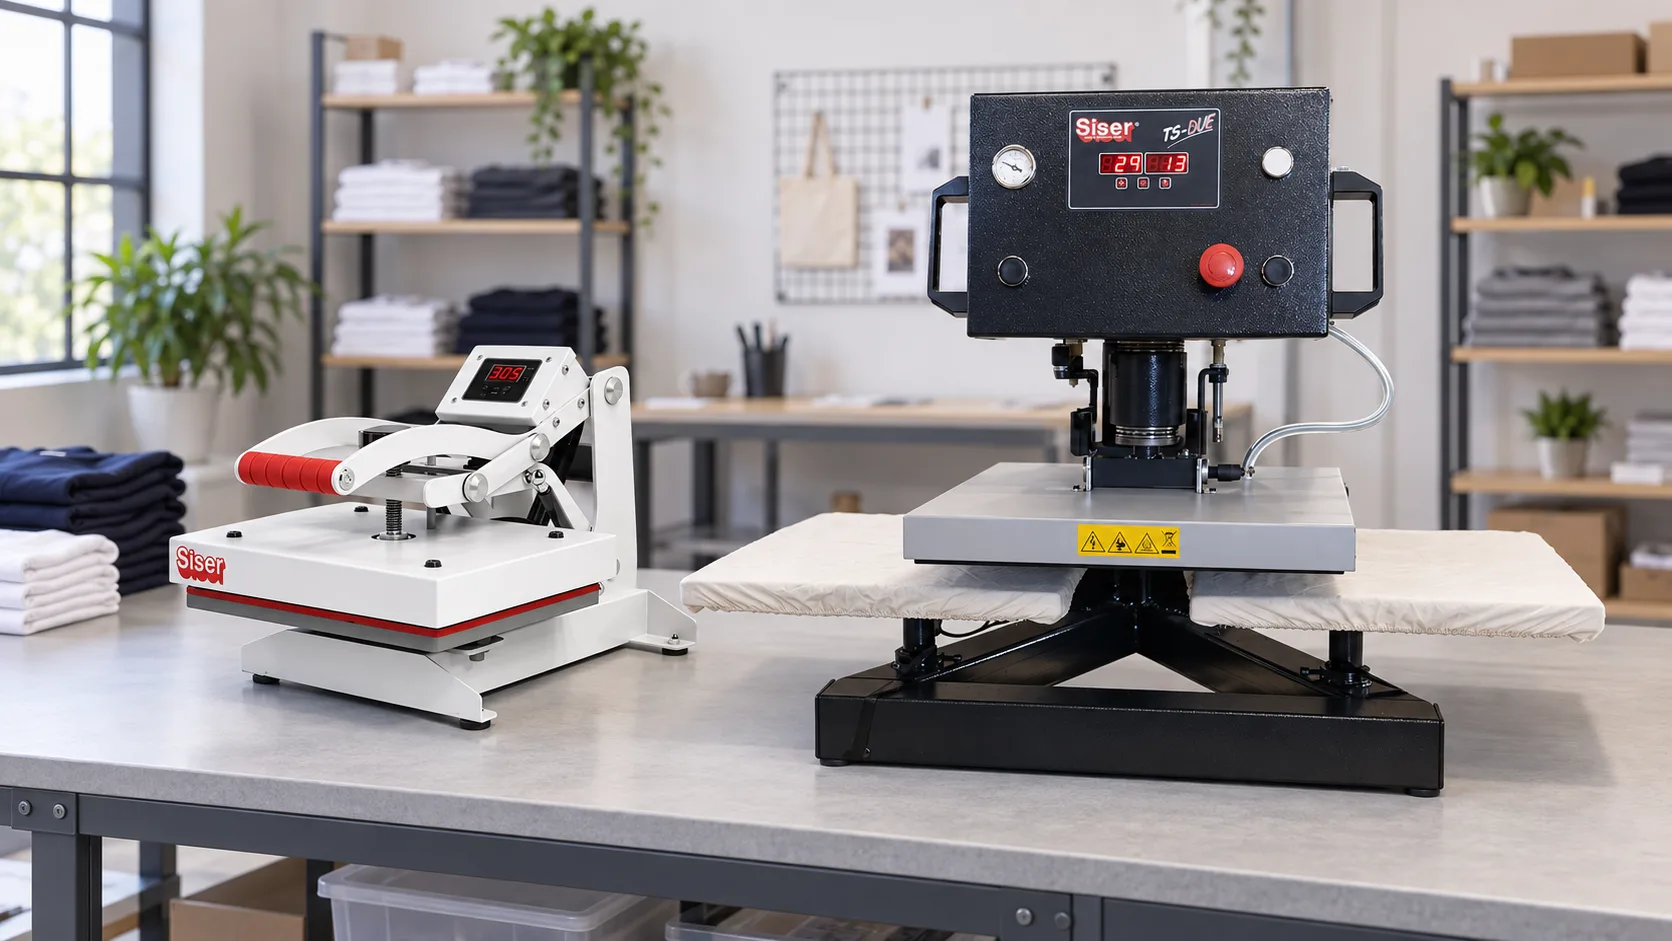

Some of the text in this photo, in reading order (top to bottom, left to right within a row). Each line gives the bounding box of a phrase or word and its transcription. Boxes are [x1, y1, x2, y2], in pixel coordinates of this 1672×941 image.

[1163, 112, 1216, 142] TS-DUE
[1115, 156, 1140, 172] 29
[1167, 156, 1187, 172] 13
[488, 366, 523, 380] 305
[177, 545, 226, 578] Siser
